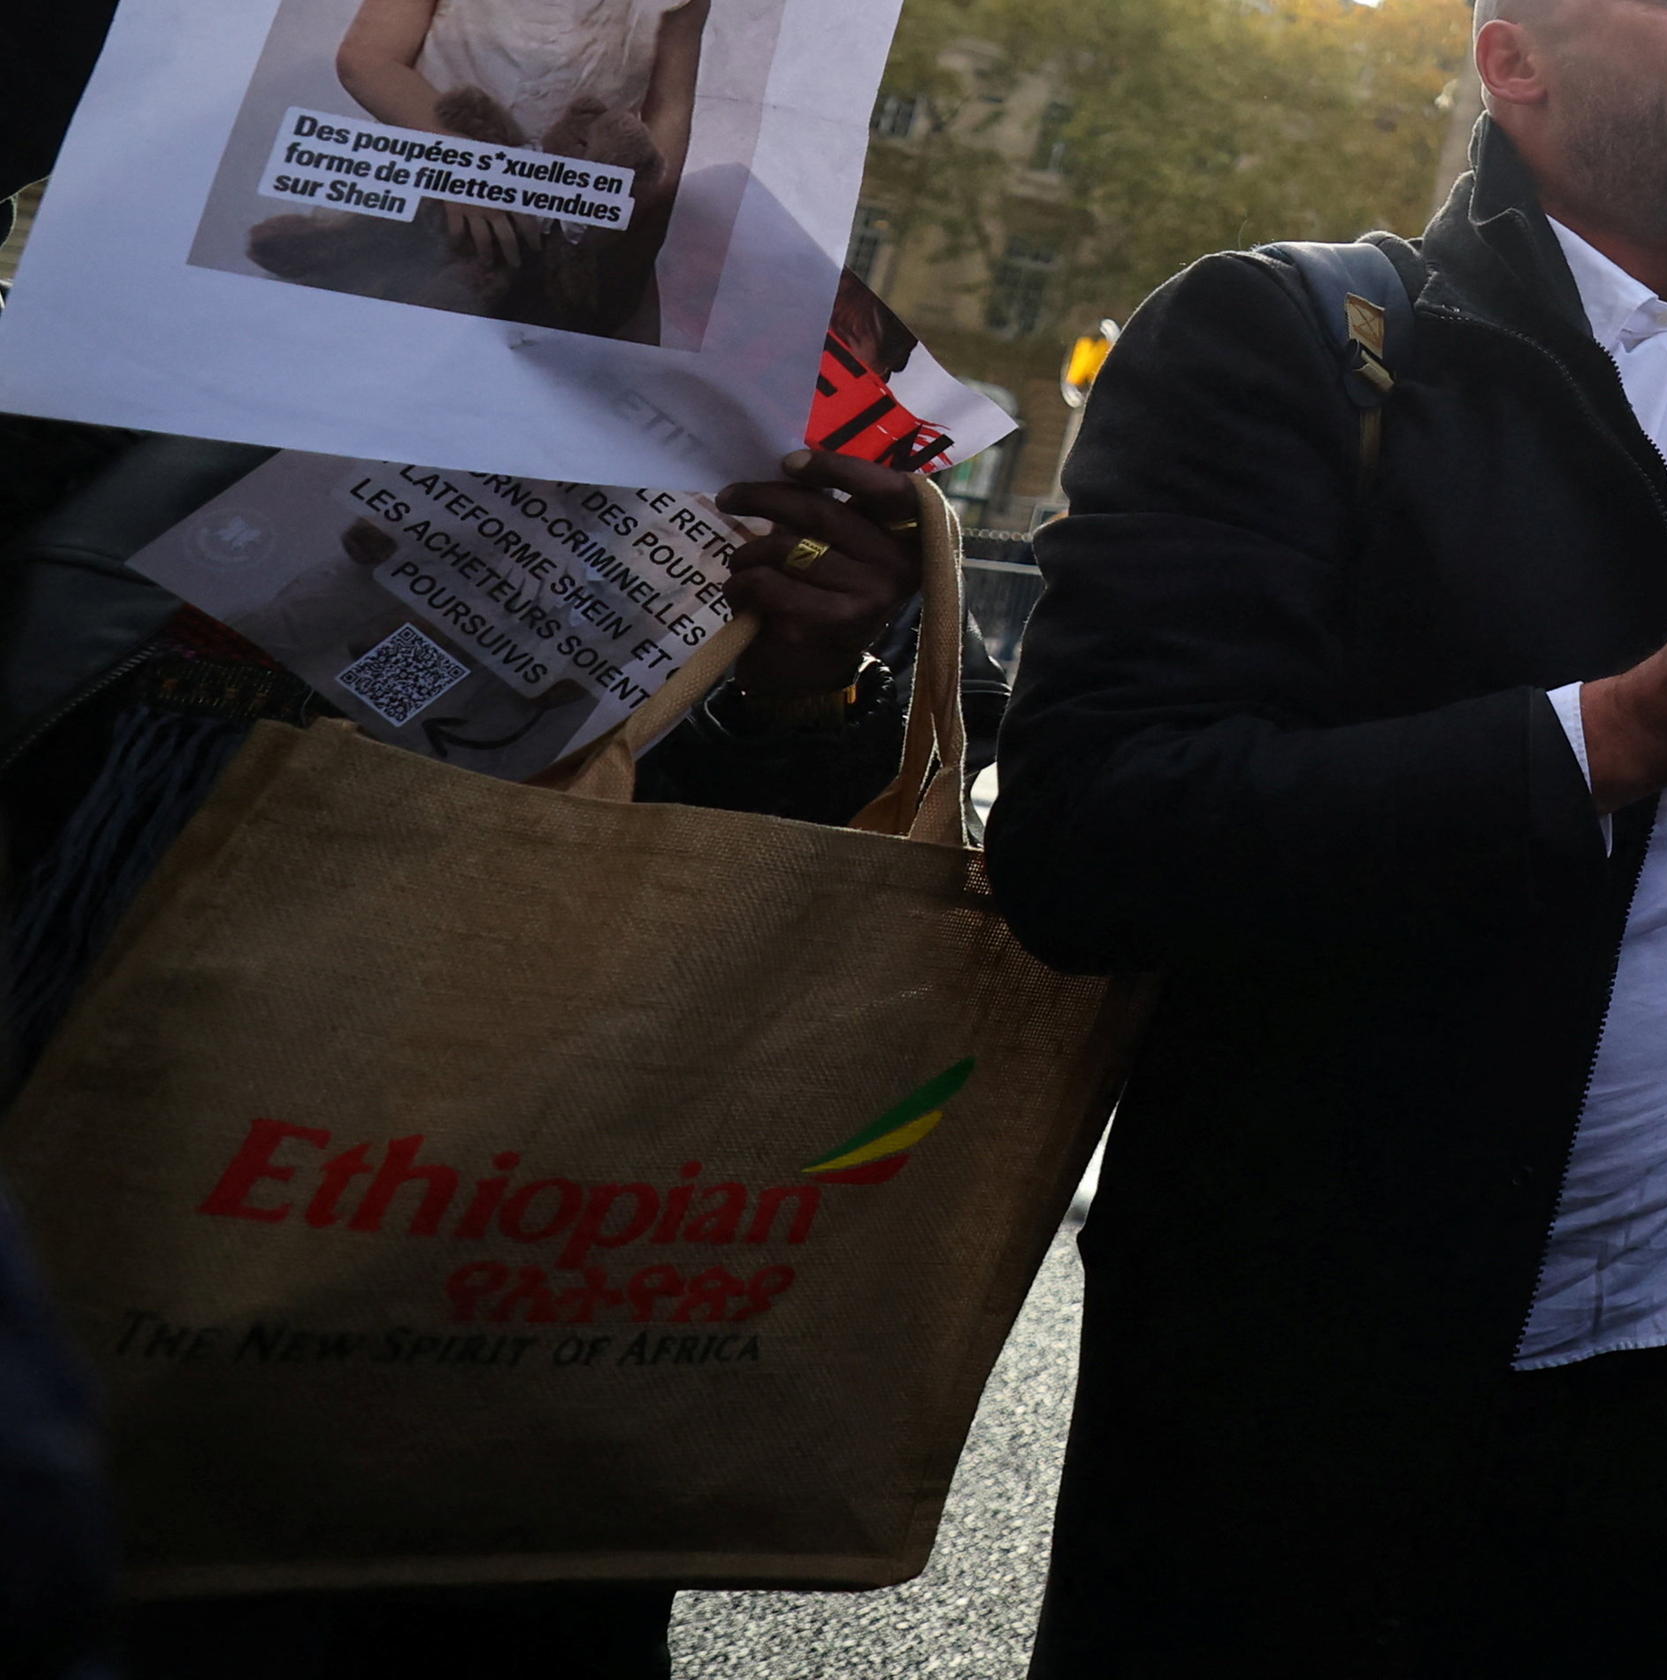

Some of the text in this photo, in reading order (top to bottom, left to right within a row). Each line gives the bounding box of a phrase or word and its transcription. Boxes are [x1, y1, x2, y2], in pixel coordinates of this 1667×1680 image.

[273, 174, 406, 213] sur Shein
[284, 142, 622, 223] forme de fillettes vendues
[293, 115, 349, 145] Des
[351, 130, 473, 169] poupées
[593, 174, 623, 195] en
[581, 491, 638, 536] DES
[636, 488, 737, 568] LE RETR
[350, 478, 650, 708] LES ACHETEURS SOIENT
[400, 465, 672, 668] LATEFORME SHEIN ET
[391, 561, 548, 684] POURSUIVIS
[194, 1117, 823, 1270] Ethiopian
[113, 1309, 761, 1367] THE NEW SPIRIT OF AFRICA
